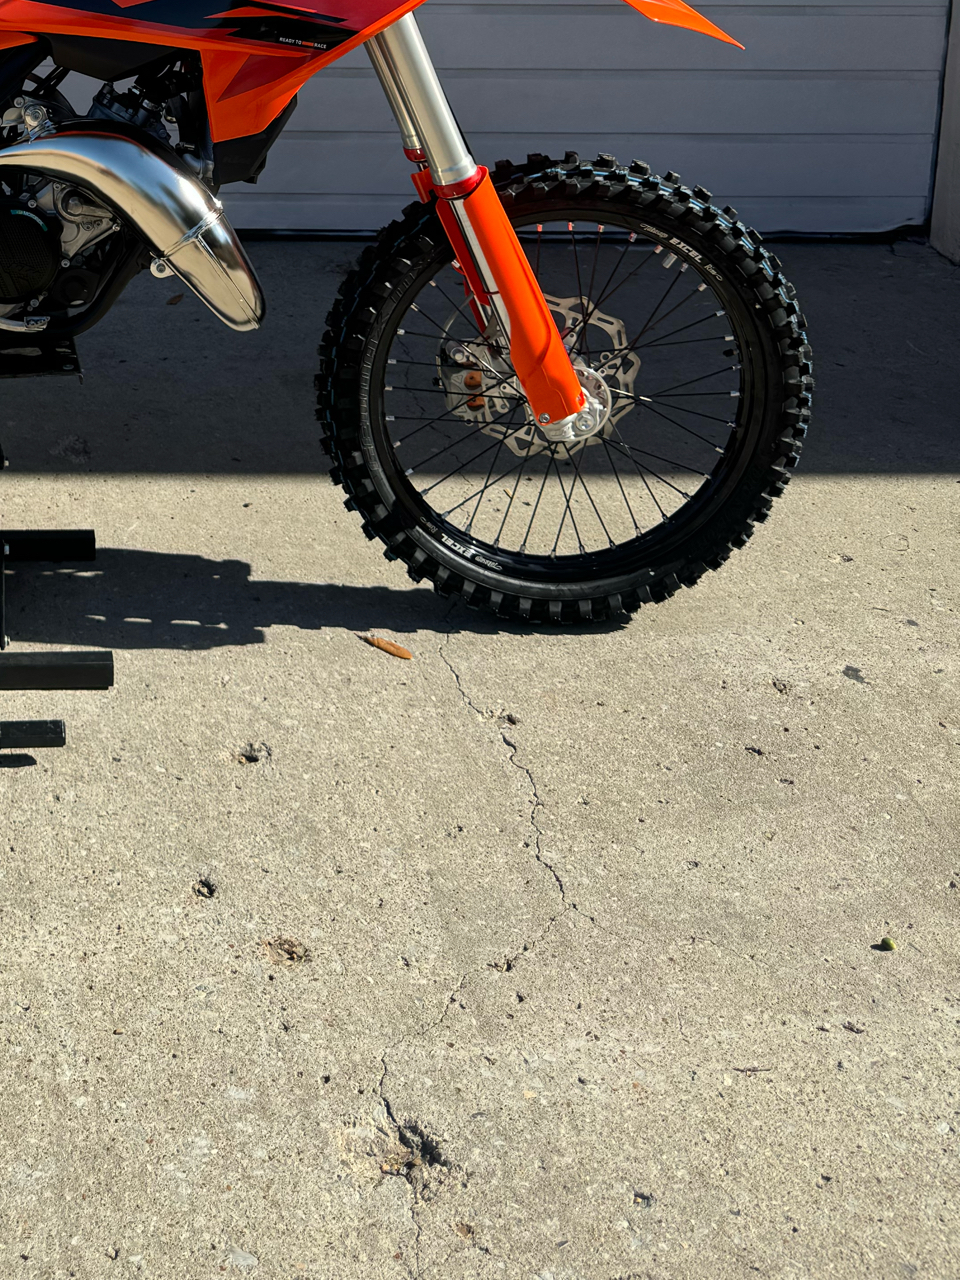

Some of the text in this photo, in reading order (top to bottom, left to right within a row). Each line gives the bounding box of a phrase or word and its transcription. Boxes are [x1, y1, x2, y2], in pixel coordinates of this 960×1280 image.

[279, 36, 295, 44] READY
[669, 236, 703, 263] EXCEL
[441, 532, 476, 559] EXCEL
